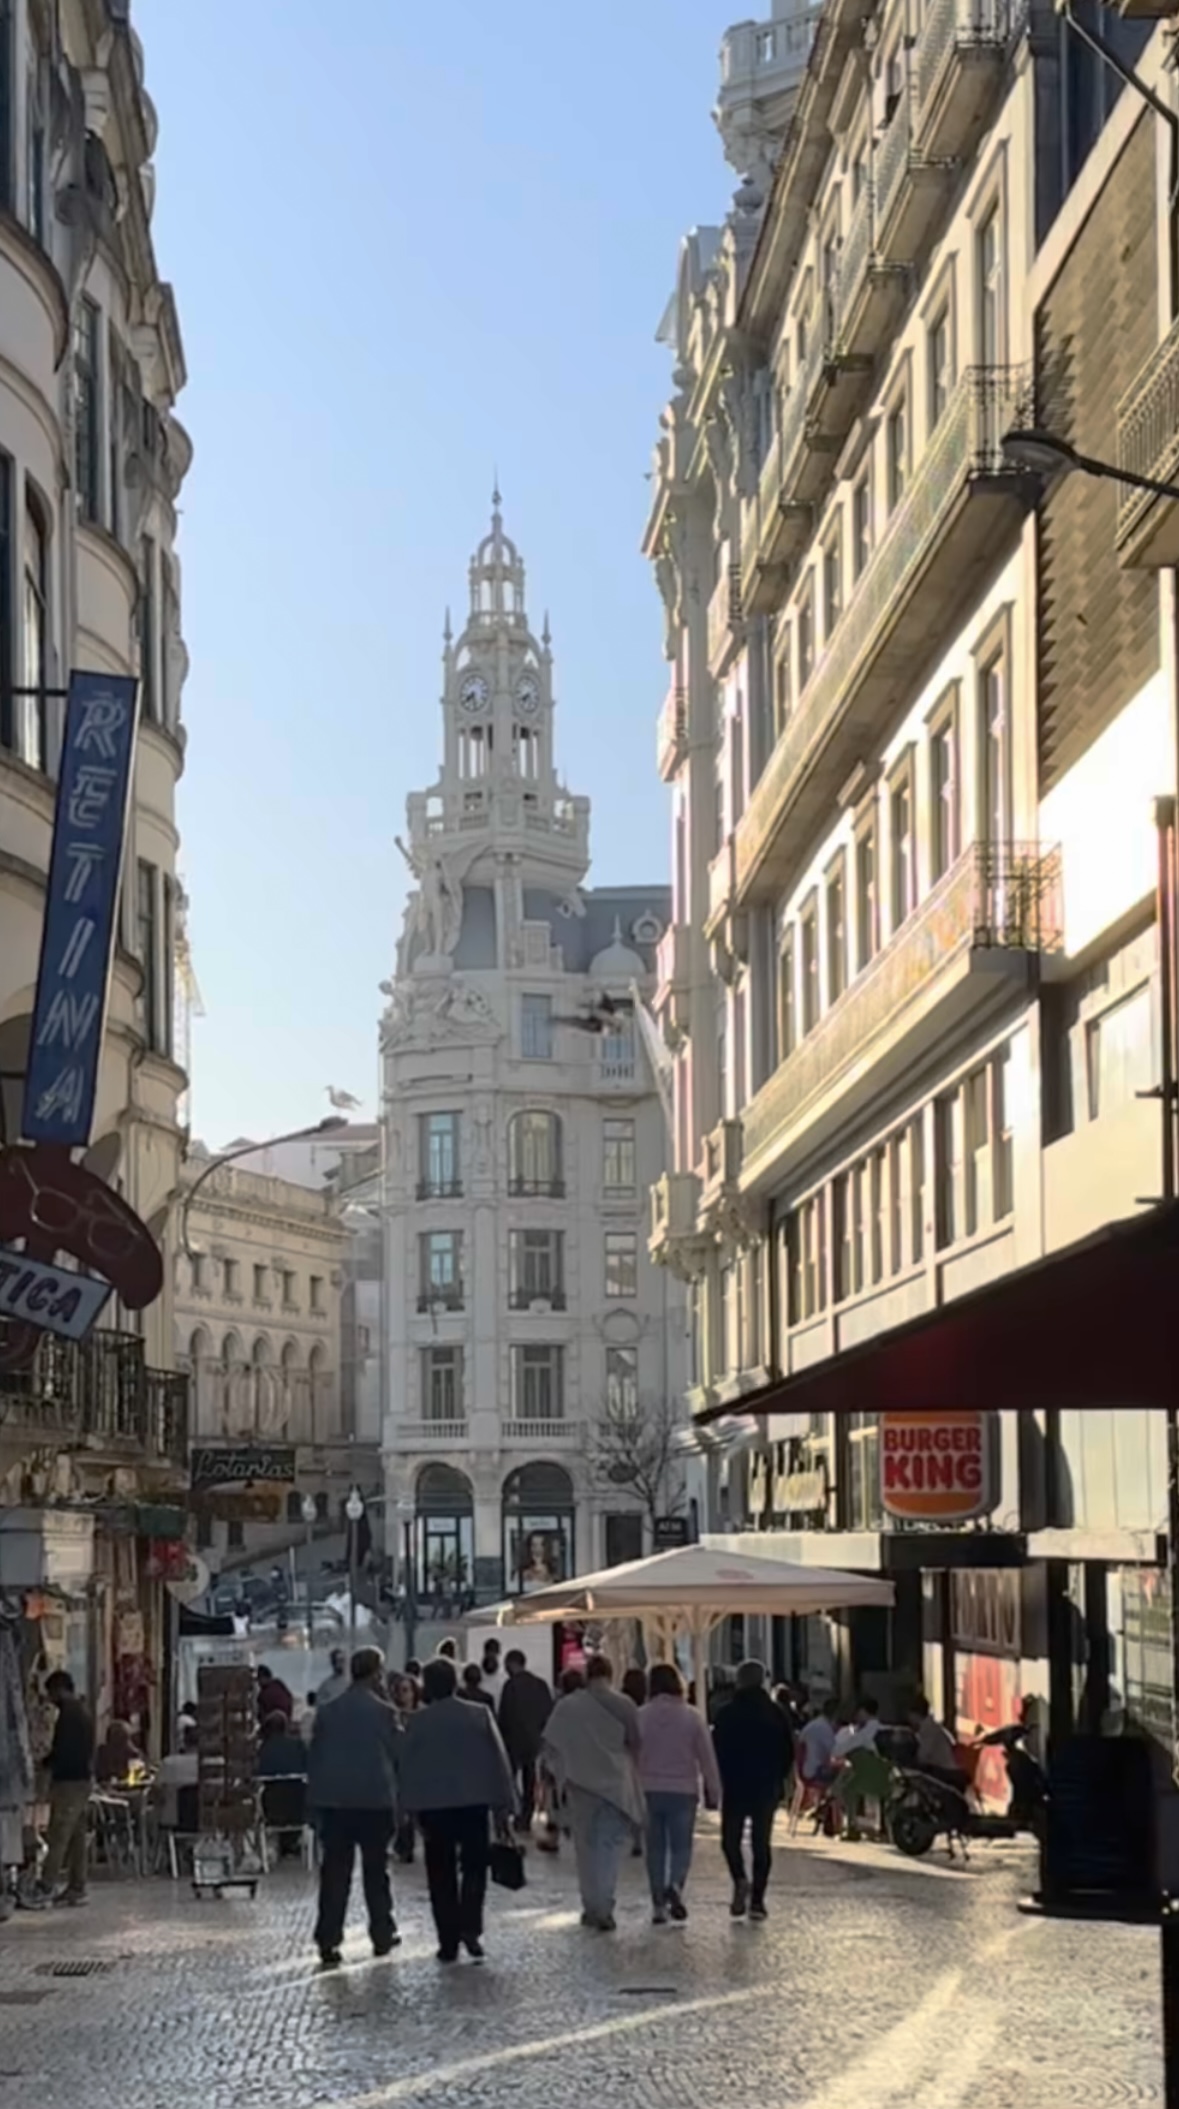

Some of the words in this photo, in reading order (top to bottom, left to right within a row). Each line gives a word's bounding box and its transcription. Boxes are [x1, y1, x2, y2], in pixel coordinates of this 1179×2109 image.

[35, 689, 126, 1122] RETINA
[884, 1427, 982, 1452] BURGER
[193, 1448, 293, 1481] Lotarias
[884, 1454, 982, 1490] KING
